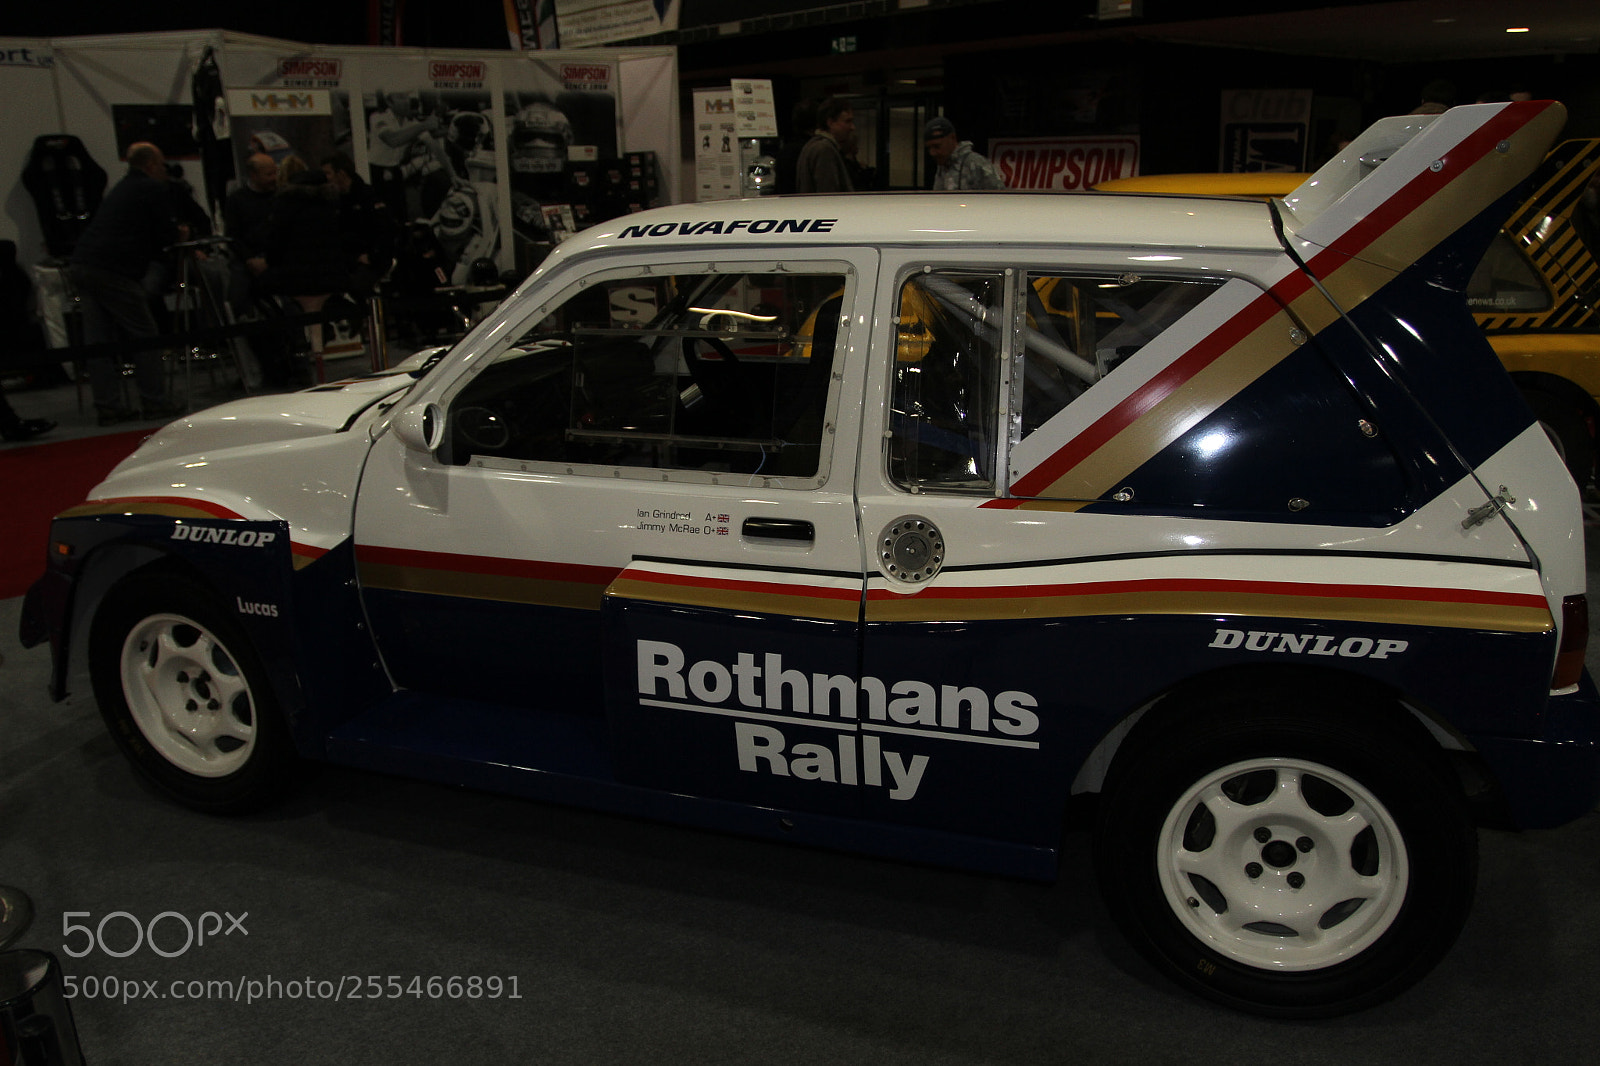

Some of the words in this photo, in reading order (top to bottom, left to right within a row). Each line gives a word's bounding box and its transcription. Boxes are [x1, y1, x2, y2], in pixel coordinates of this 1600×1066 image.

[282, 61, 338, 76] SIMPSON
[432, 63, 481, 78] SIMPSON
[563, 66, 607, 80] SIMPSON
[1000, 147, 1126, 190] SIMPSON
[617, 218, 838, 239] NOVAFONE
[637, 508, 650, 518] Ian
[170, 524, 276, 548] DUNLOP
[637, 522, 666, 533] Jimmy
[669, 523, 700, 534] McRae
[236, 595, 279, 618] Lucas
[1208, 628, 1409, 659] DUNLOP
[637, 639, 1040, 736] Rothmans
[734, 722, 929, 801] Rally
